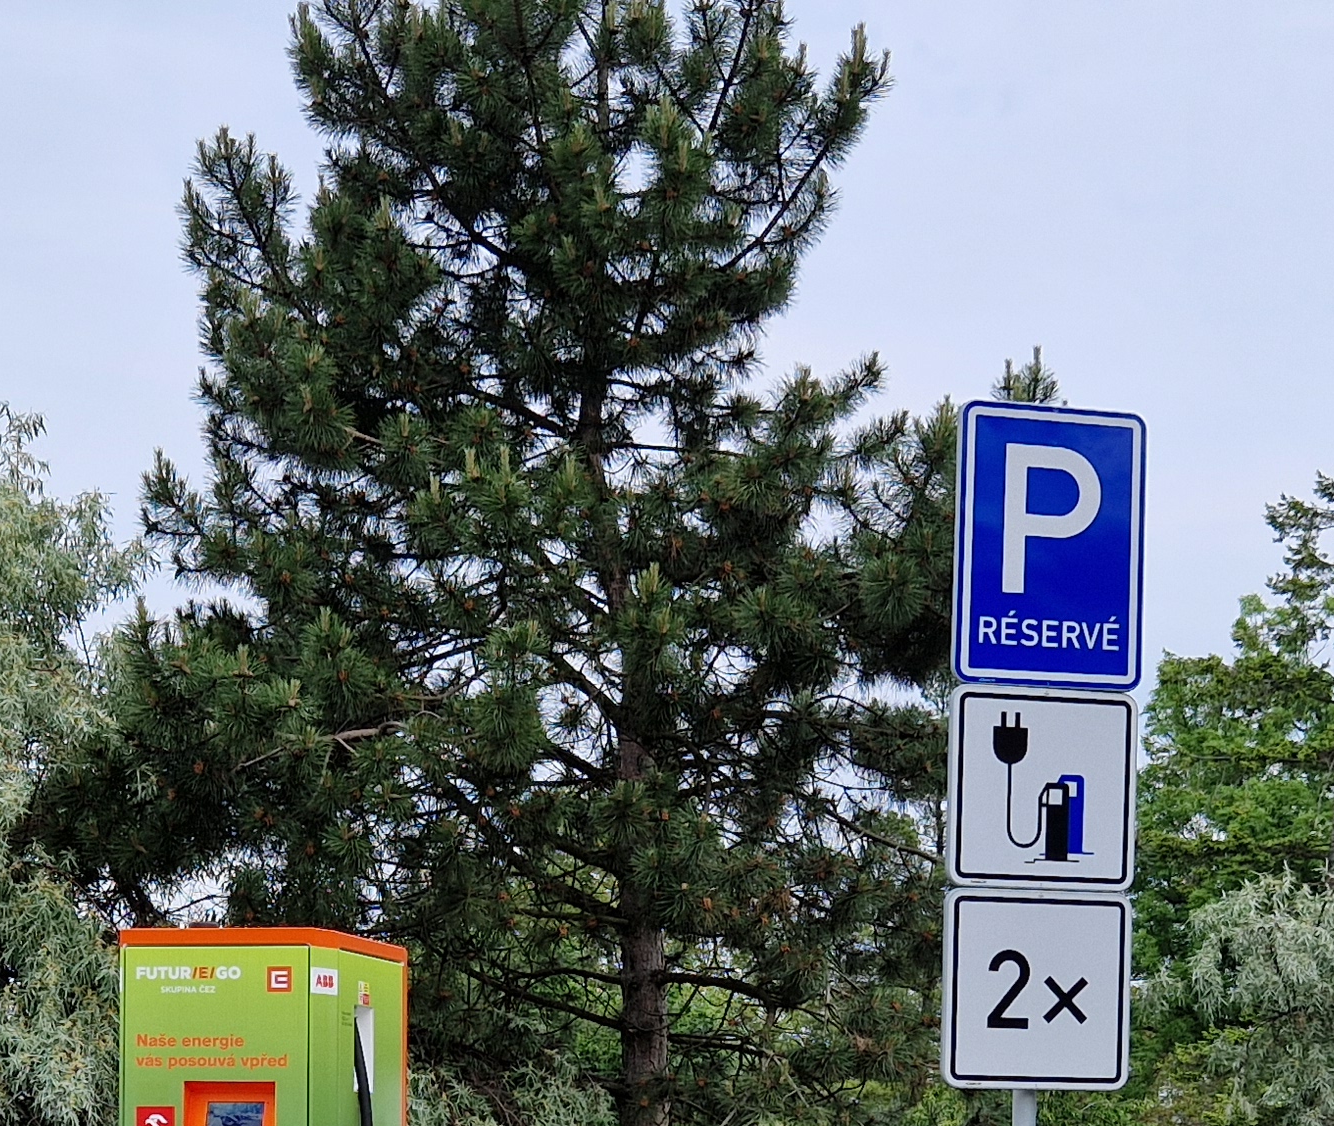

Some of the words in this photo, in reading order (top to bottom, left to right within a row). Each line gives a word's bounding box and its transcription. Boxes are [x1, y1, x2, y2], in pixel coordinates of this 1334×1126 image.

[1001, 442, 1102, 594] P
[977, 609, 1121, 652] RÉSERVÉ
[135, 966, 242, 980] FUTUR/E/GO
[315, 973, 334, 989] ABB
[160, 985, 197, 994] SKUPINA
[198, 984, 216, 994] ČEZ
[136, 1034, 177, 1048] Naše
[181, 1035, 245, 1051] energie
[136, 1054, 163, 1068] vás
[168, 1054, 236, 1070] posouvá
[241, 1054, 288, 1070] vpřed
